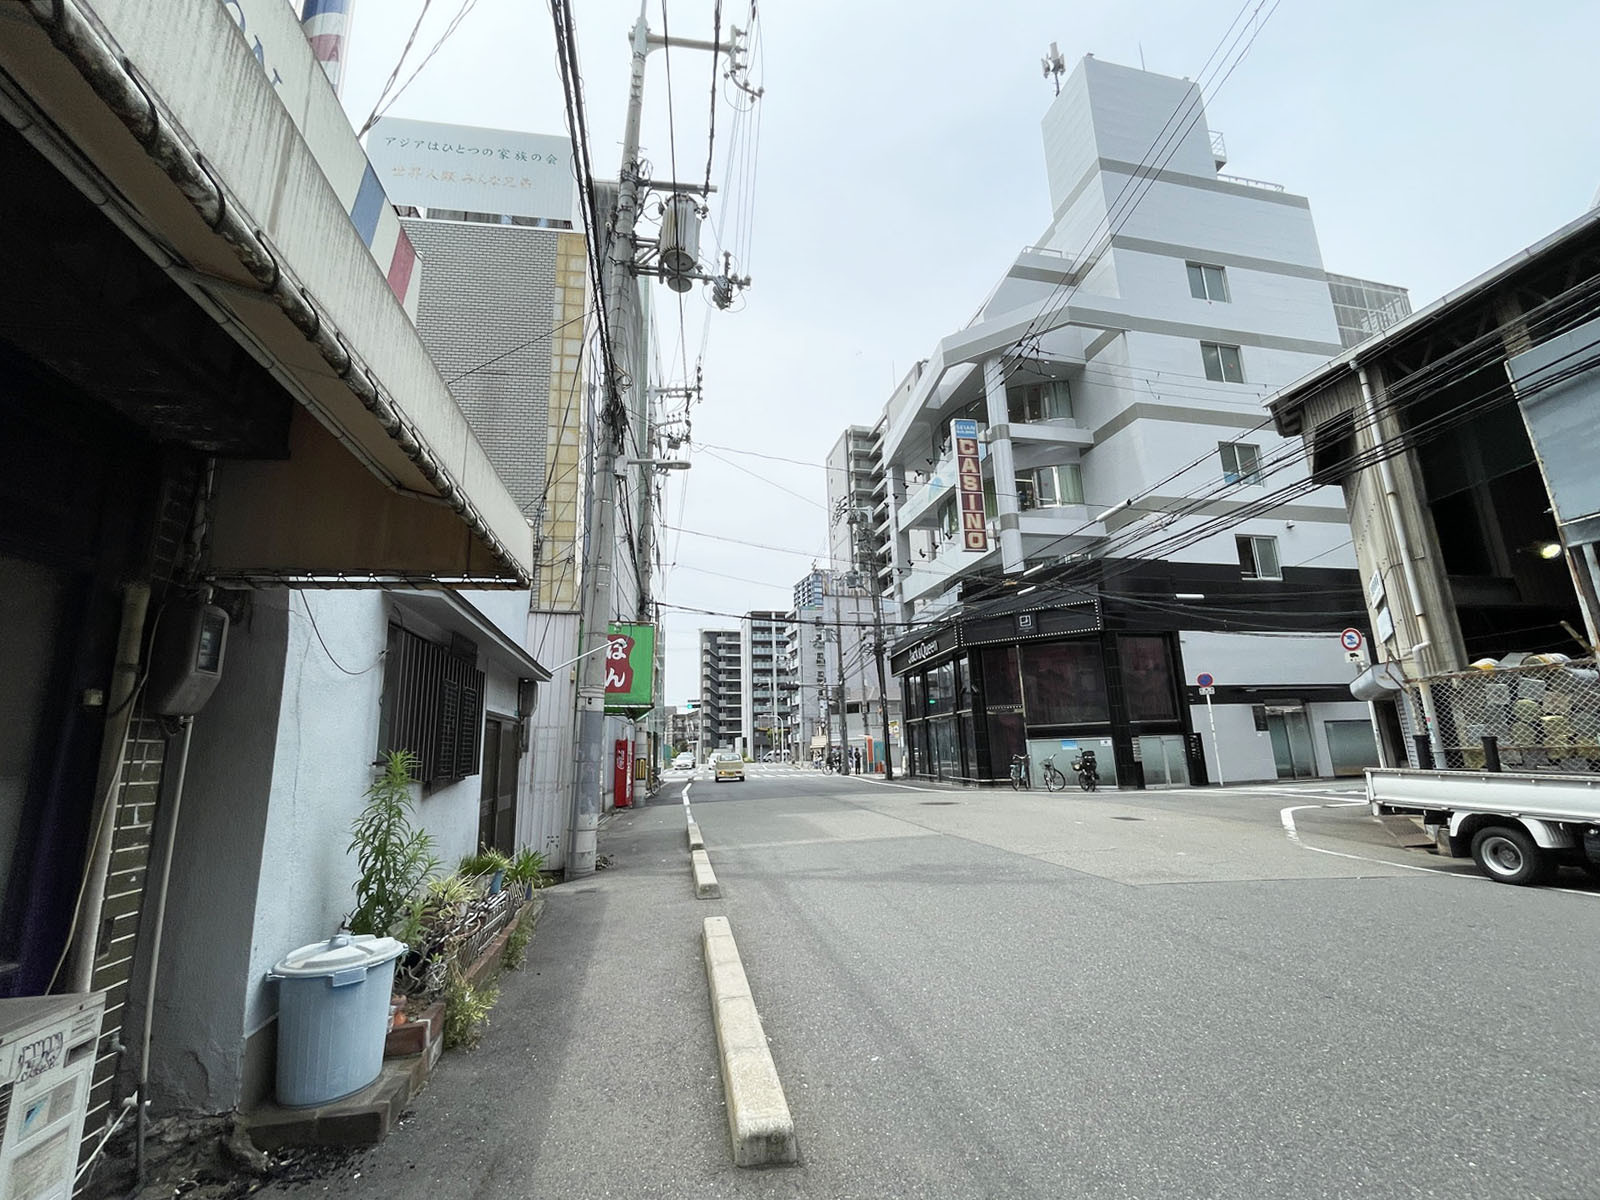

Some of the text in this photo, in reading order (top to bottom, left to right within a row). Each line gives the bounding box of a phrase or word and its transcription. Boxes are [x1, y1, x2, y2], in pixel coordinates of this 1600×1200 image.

[385, 137, 558, 165] アジアはひとつの家族の会
[959, 439, 984, 548] CASINO
